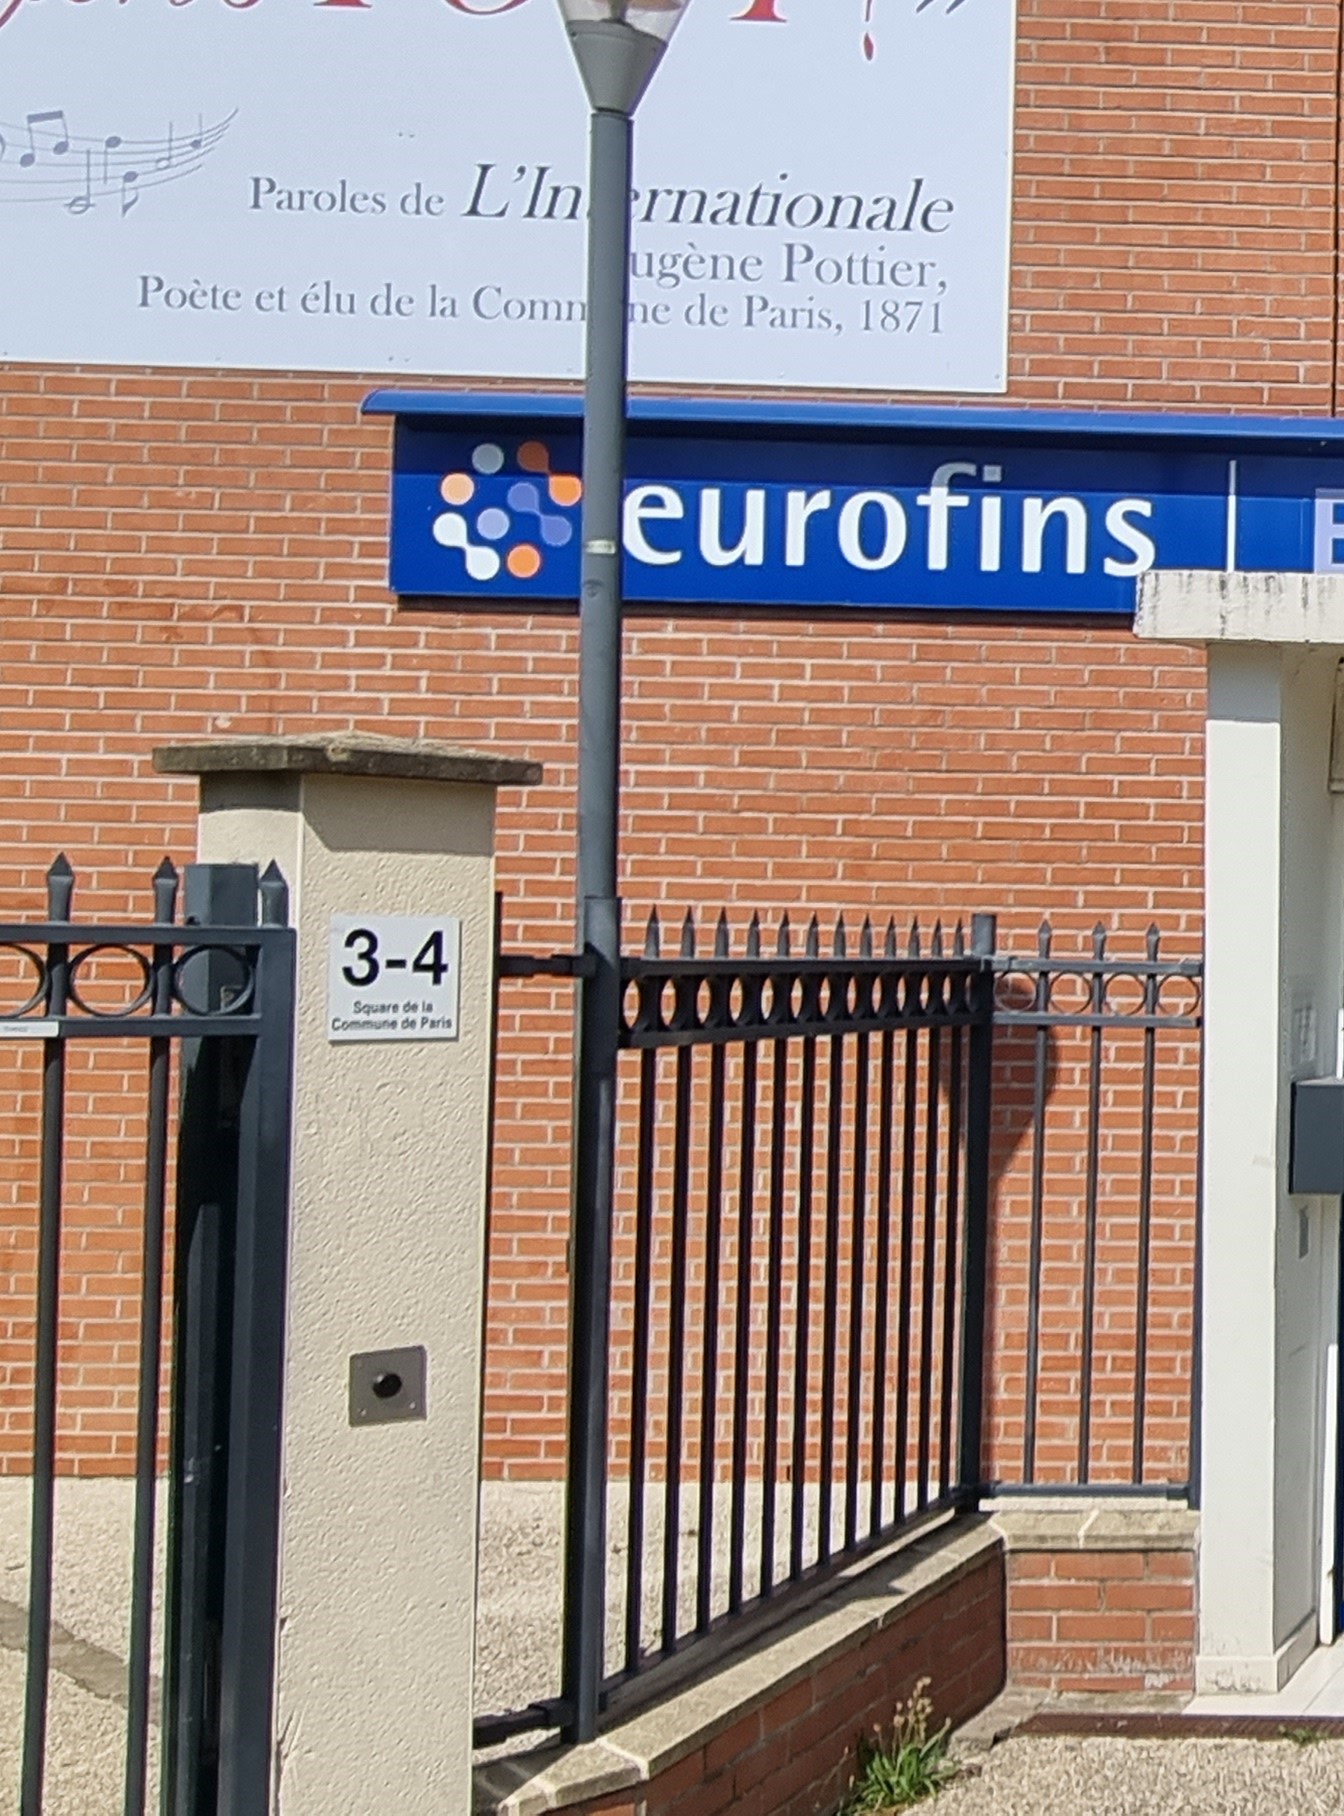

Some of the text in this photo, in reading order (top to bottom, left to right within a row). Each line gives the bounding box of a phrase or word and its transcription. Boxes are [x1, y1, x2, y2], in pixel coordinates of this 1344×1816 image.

[249, 176, 387, 217] Paroles
[400, 183, 446, 218] de
[630, 241, 949, 293] ugène Pottier,
[137, 274, 944, 336] Poète et élu de la Commne de Paris, 1871
[622, 461, 1157, 579] eurofins
[342, 927, 449, 988] 3-4
[331, 1016, 453, 1032] Commune de Paris
[353, 1000, 434, 1017] Square de la
